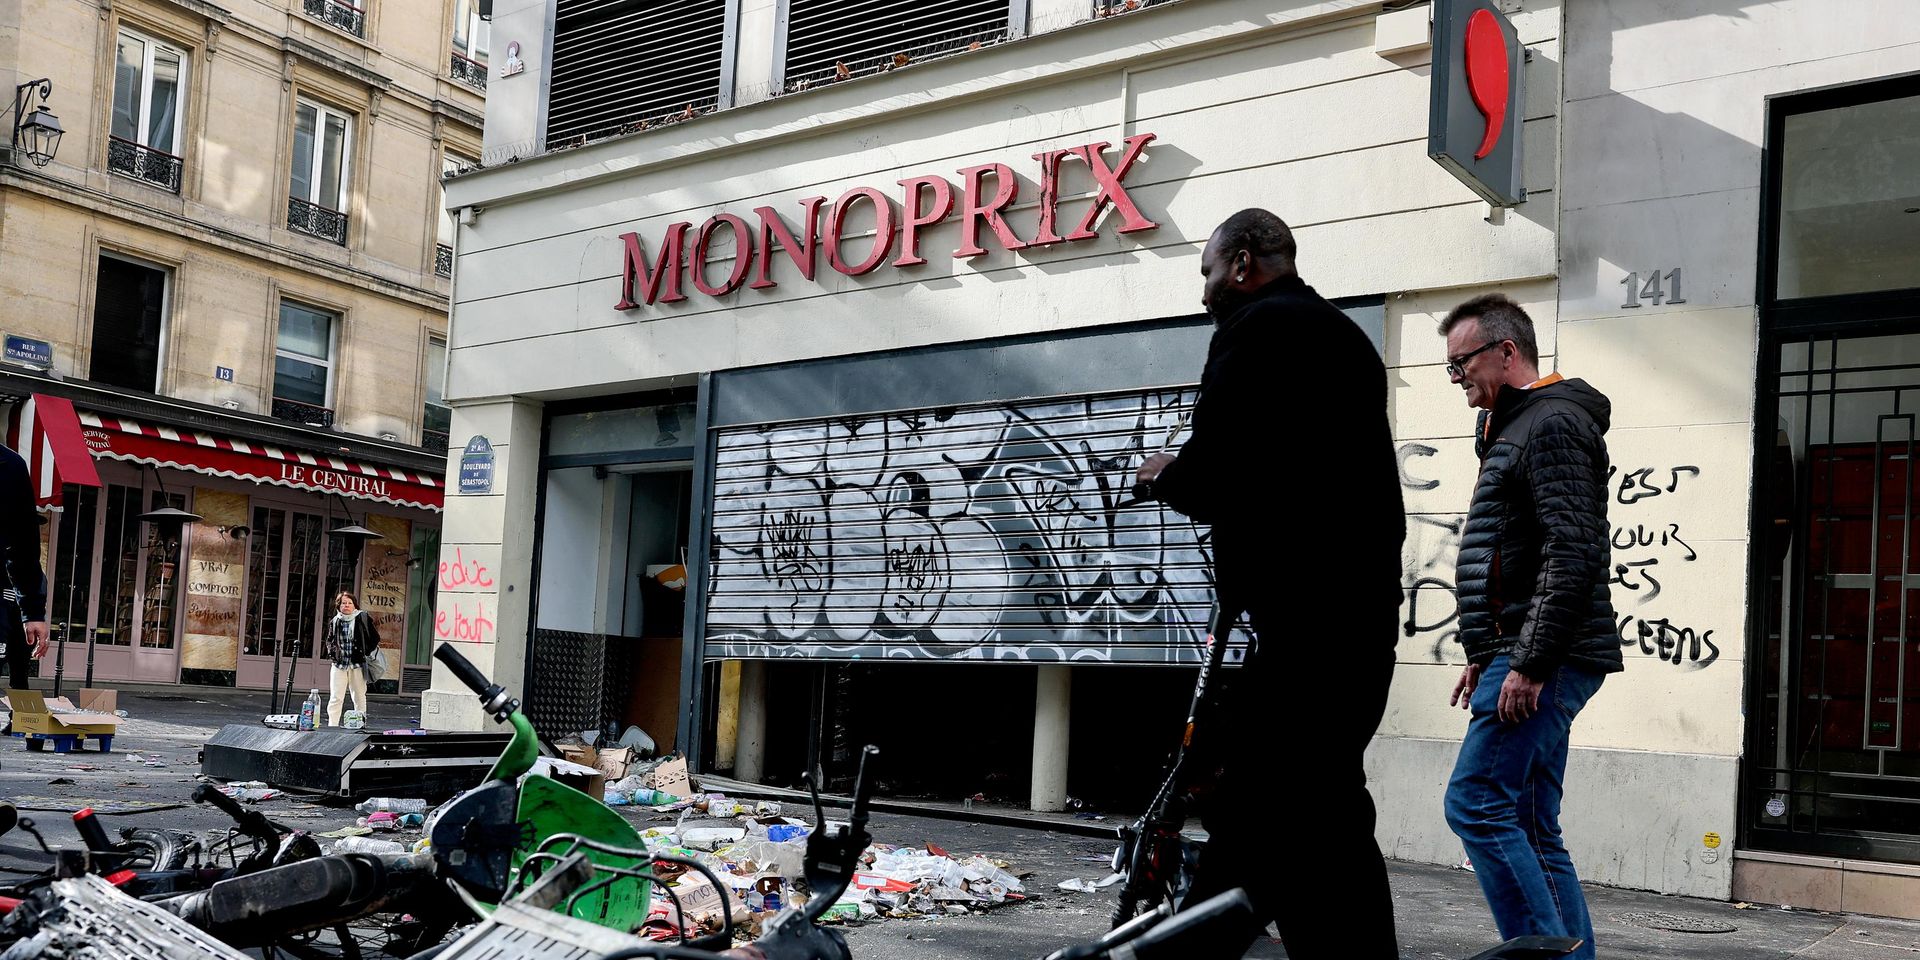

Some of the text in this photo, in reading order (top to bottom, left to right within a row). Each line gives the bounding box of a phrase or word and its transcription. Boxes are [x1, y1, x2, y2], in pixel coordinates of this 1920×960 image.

[614, 132, 1159, 311] MONOPRIX
[1620, 267, 1687, 309] 141
[22, 343, 36, 352] RUE
[16, 350, 49, 362] APOLLINE
[220, 368, 230, 379] 13
[82, 430, 111, 441] SERVICE
[83, 437, 112, 449] CONTINU
[463, 463, 491, 471] BOULEVARD
[281, 463, 391, 496] LE CENTRAL
[200, 561, 229, 574] VRAI
[188, 582, 239, 596] COMPTOIR
[367, 594, 396, 608] VINS
[1196, 633, 1217, 699] SEGWAY
